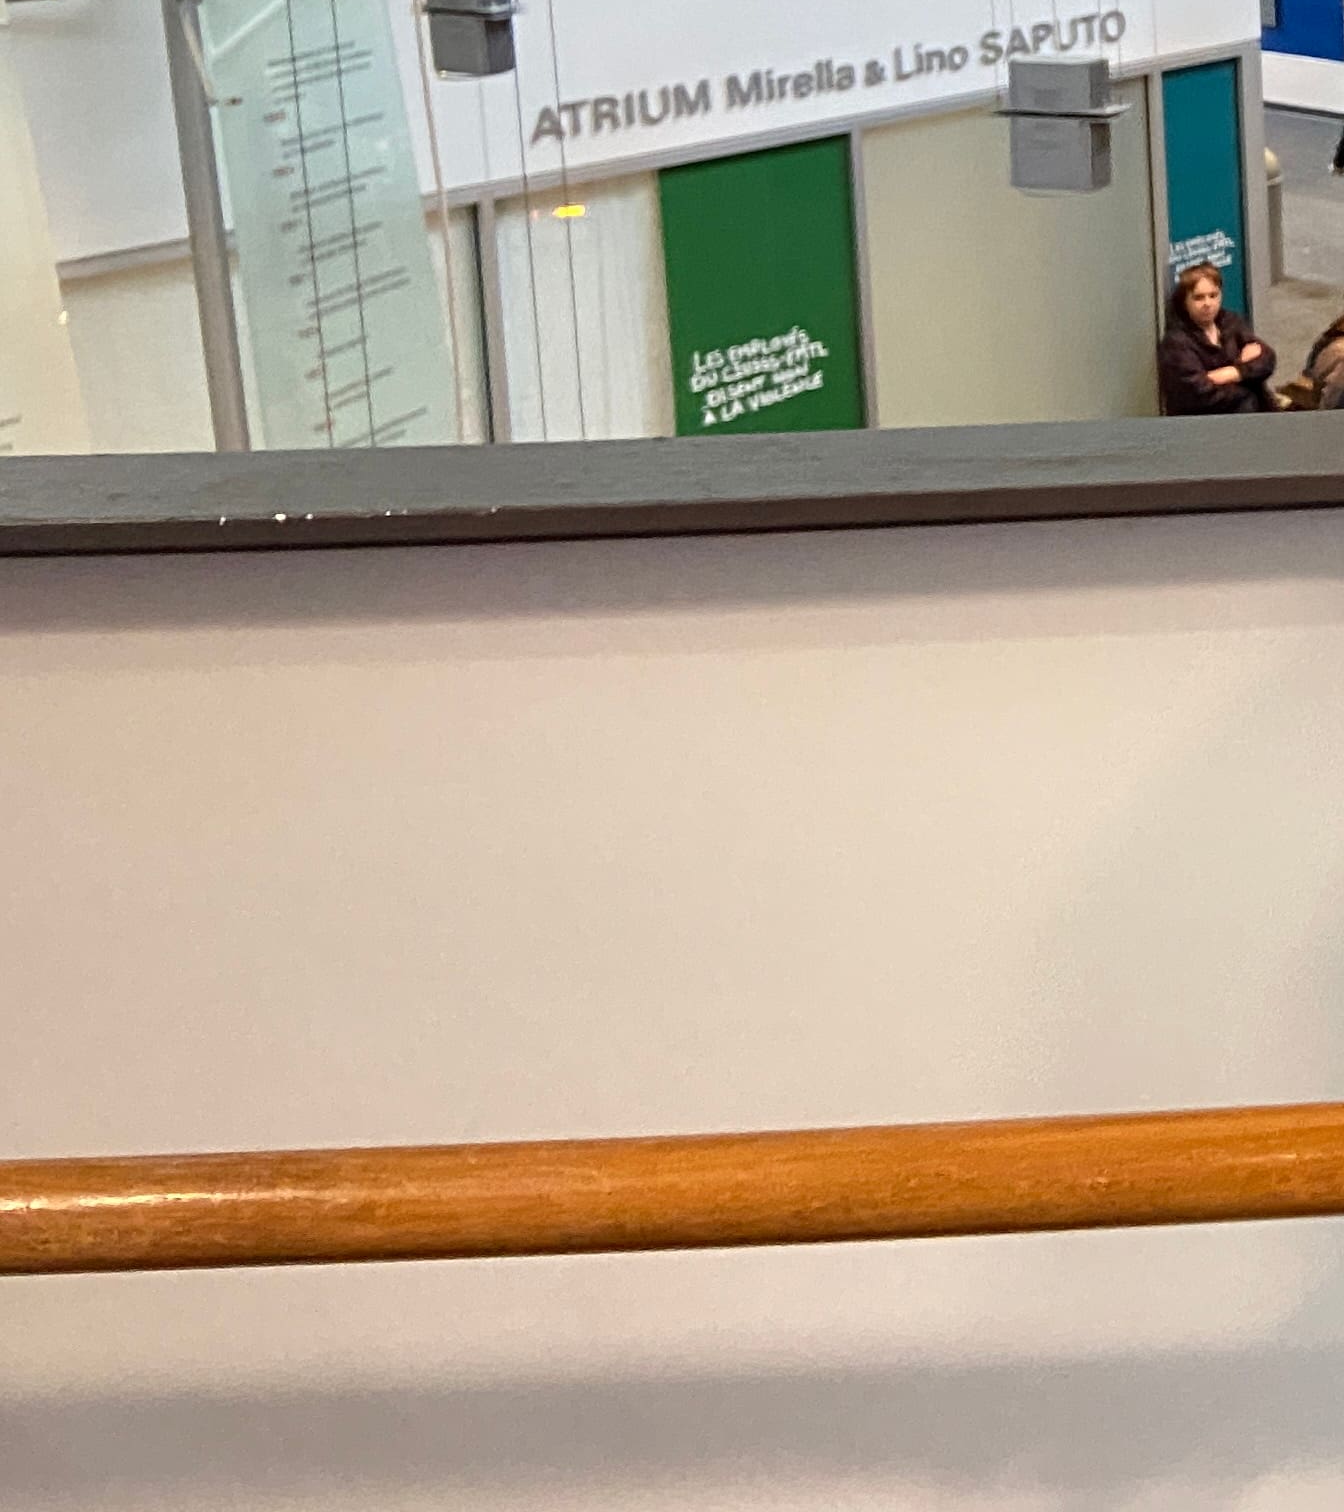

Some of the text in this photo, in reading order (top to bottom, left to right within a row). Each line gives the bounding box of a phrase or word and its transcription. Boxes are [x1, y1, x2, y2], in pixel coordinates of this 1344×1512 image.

[529, 9, 1127, 145] ATRIUM Mirella & Lino SAPUTO
